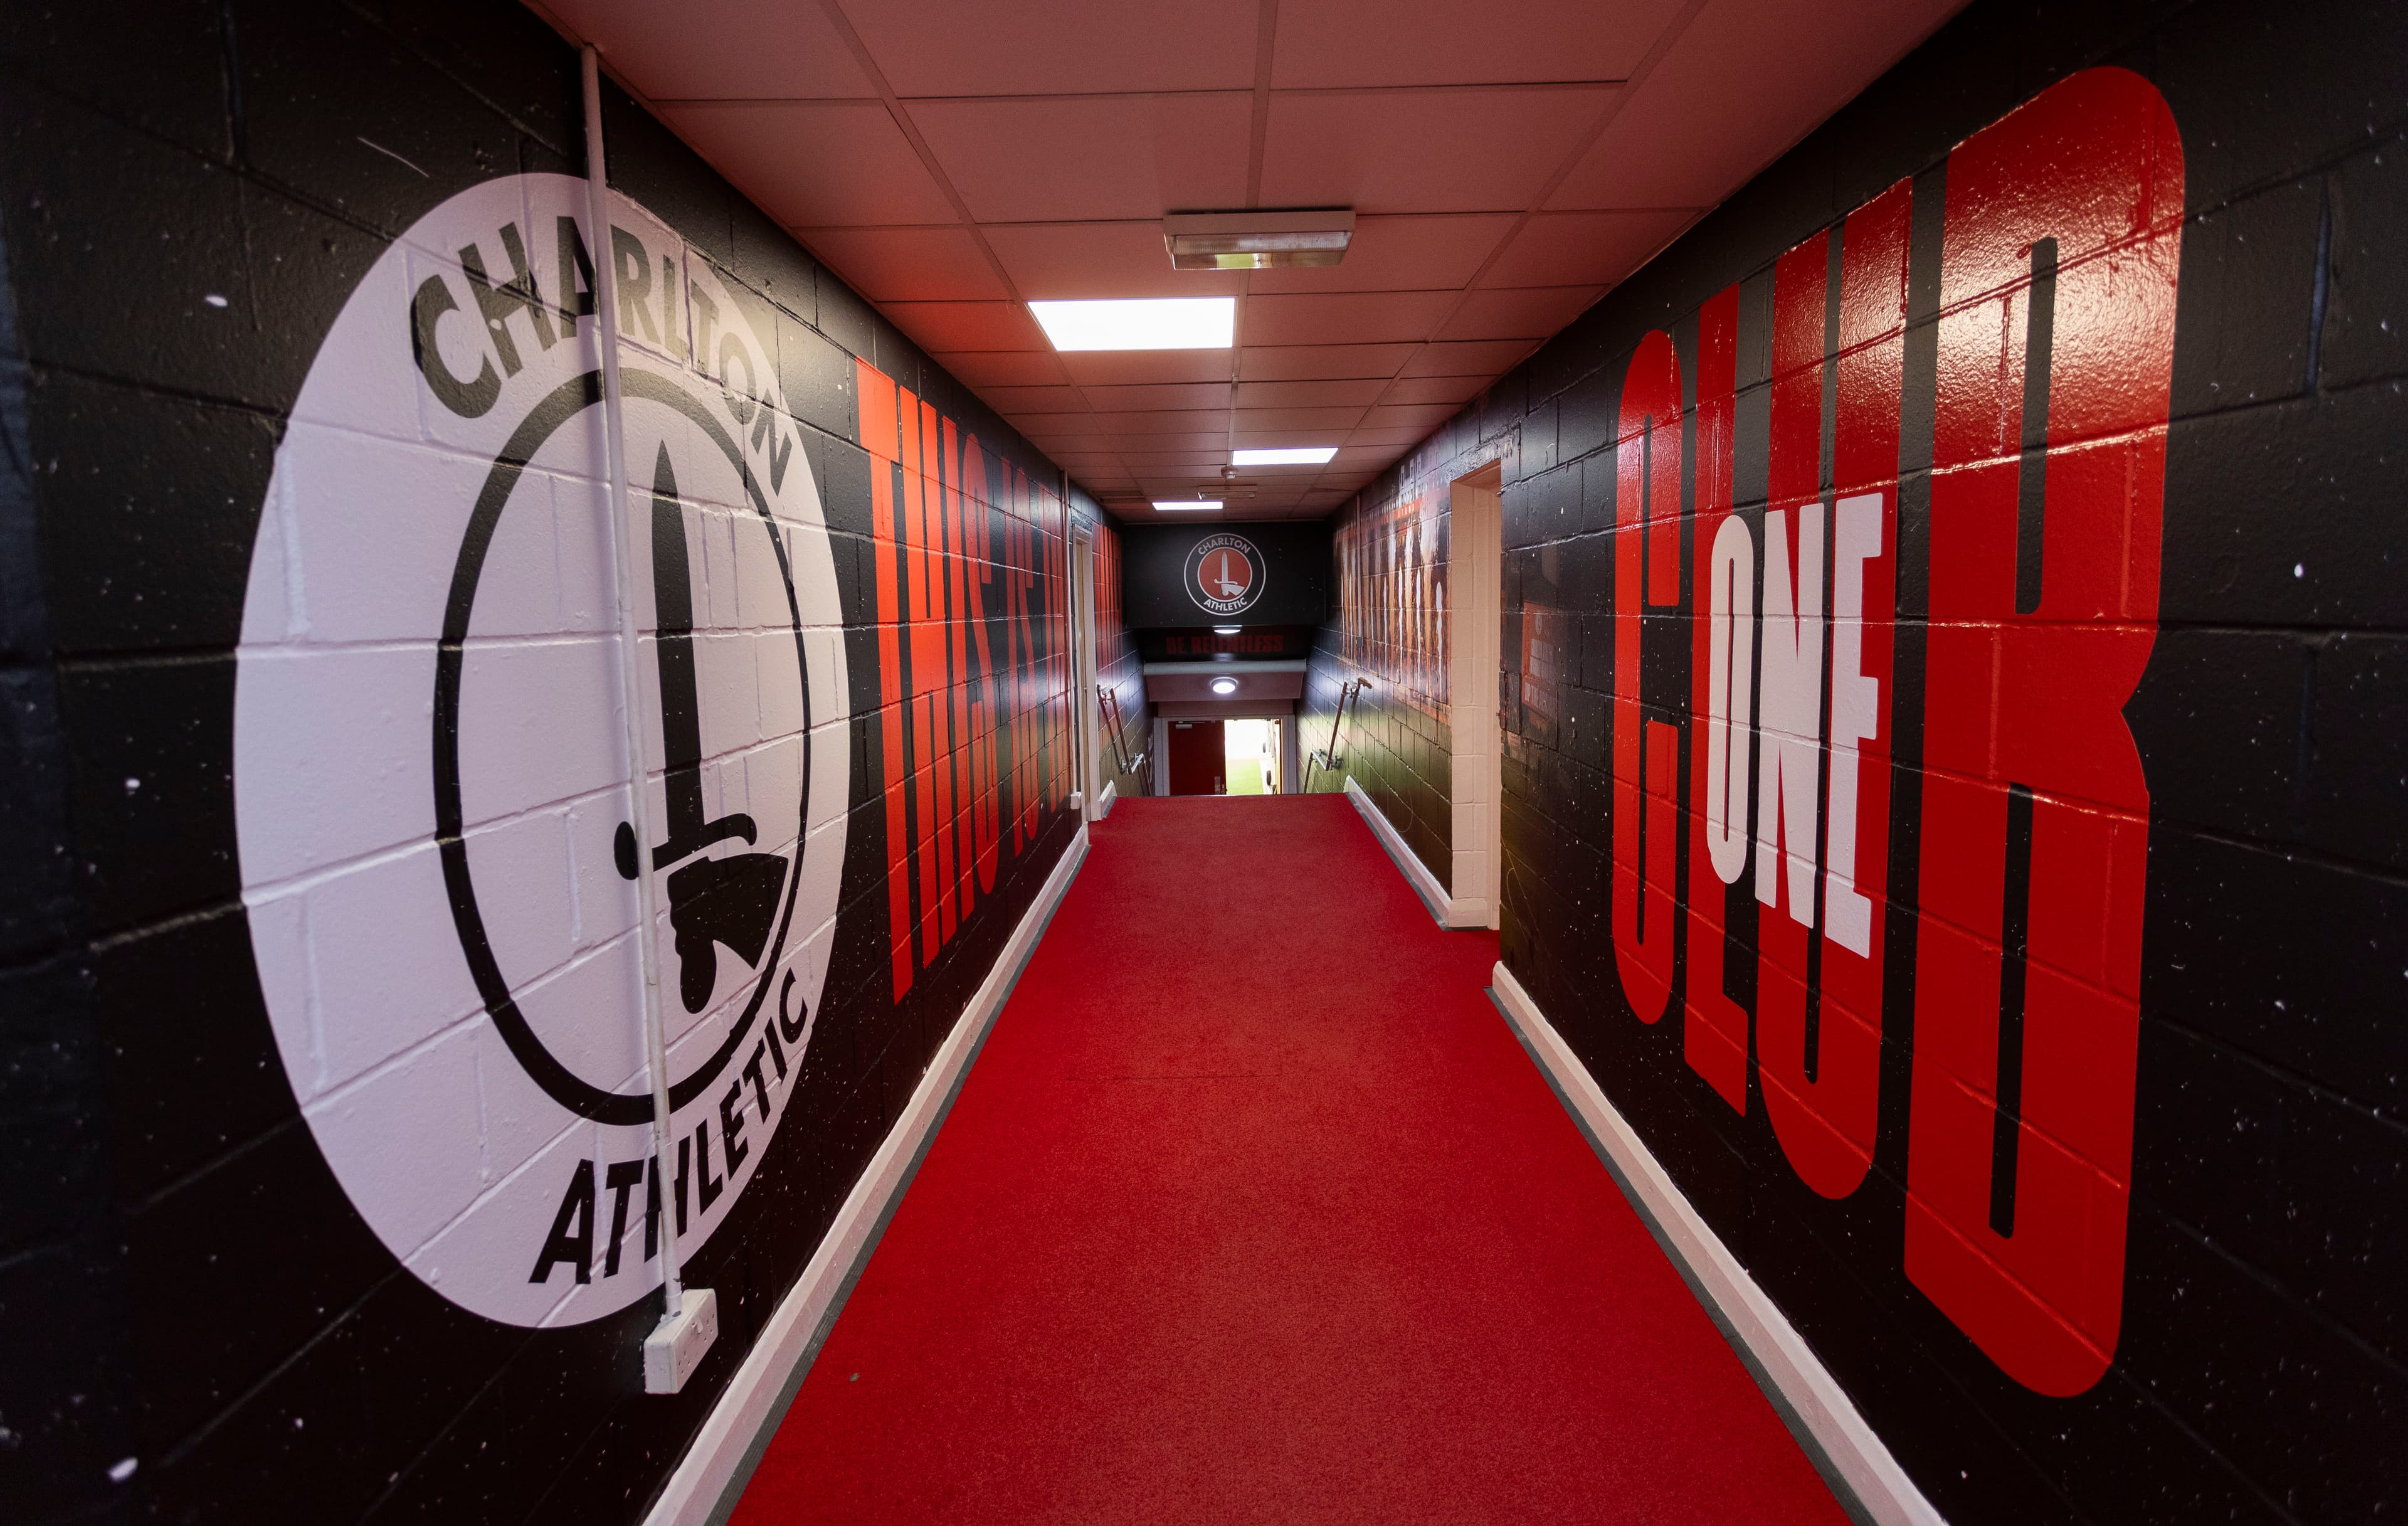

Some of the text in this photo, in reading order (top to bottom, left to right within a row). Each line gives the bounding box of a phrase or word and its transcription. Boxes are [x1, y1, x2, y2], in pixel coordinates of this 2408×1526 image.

[411, 216, 792, 494] CHARLTON
[857, 356, 998, 1005] THIS
[1001, 456, 1039, 858] IS
[1166, 634, 1284, 654] BE RELENTLESS
[1198, 538, 1250, 555] CHARLTON
[1204, 597, 1247, 611] ATHLETIC
[1610, 65, 2185, 1397] CLUB
[1706, 493, 1883, 958] ONE
[529, 968, 808, 1285] ATHLETIC
